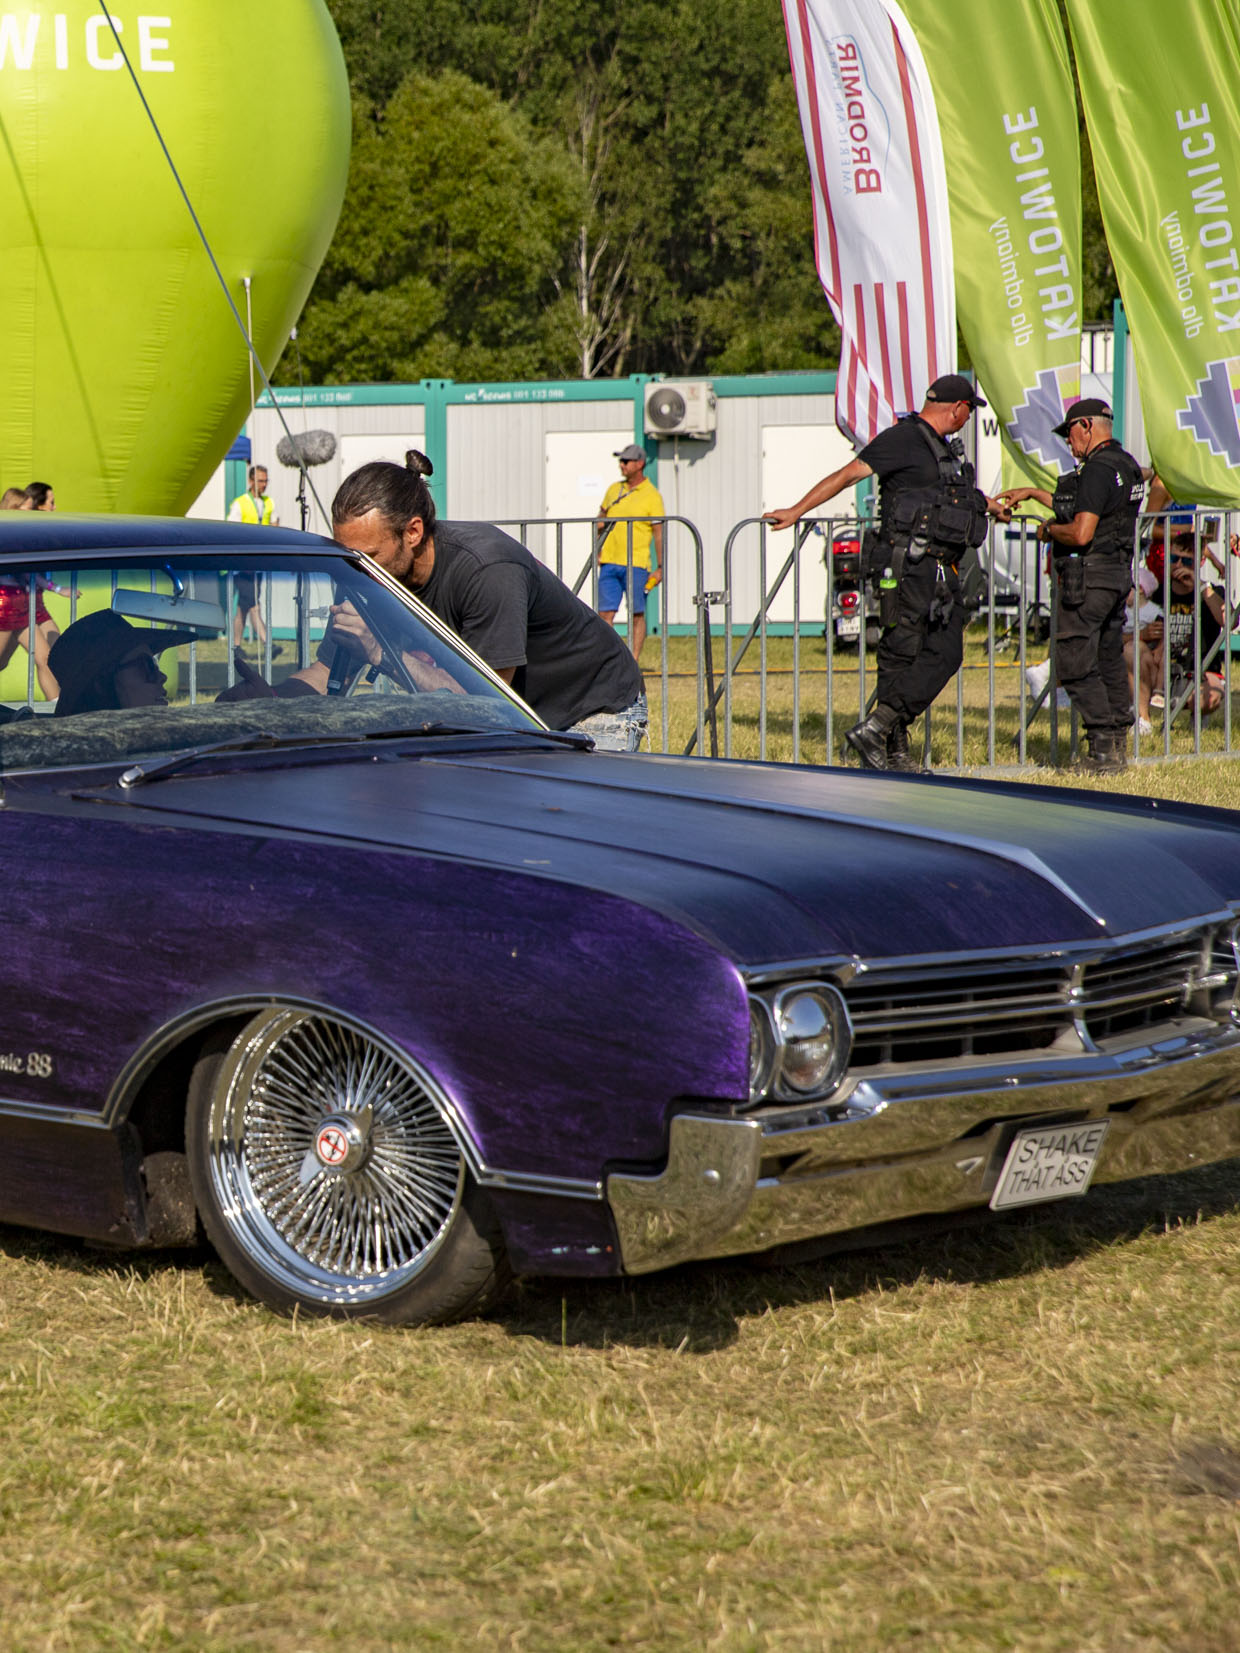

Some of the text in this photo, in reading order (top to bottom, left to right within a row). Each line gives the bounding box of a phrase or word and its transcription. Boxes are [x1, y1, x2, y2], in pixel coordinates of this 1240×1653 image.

[27, 1052, 52, 1078] 88
[1019, 1129, 1102, 1163] SHAKE
[1009, 1160, 1089, 1194] THAT ASS
